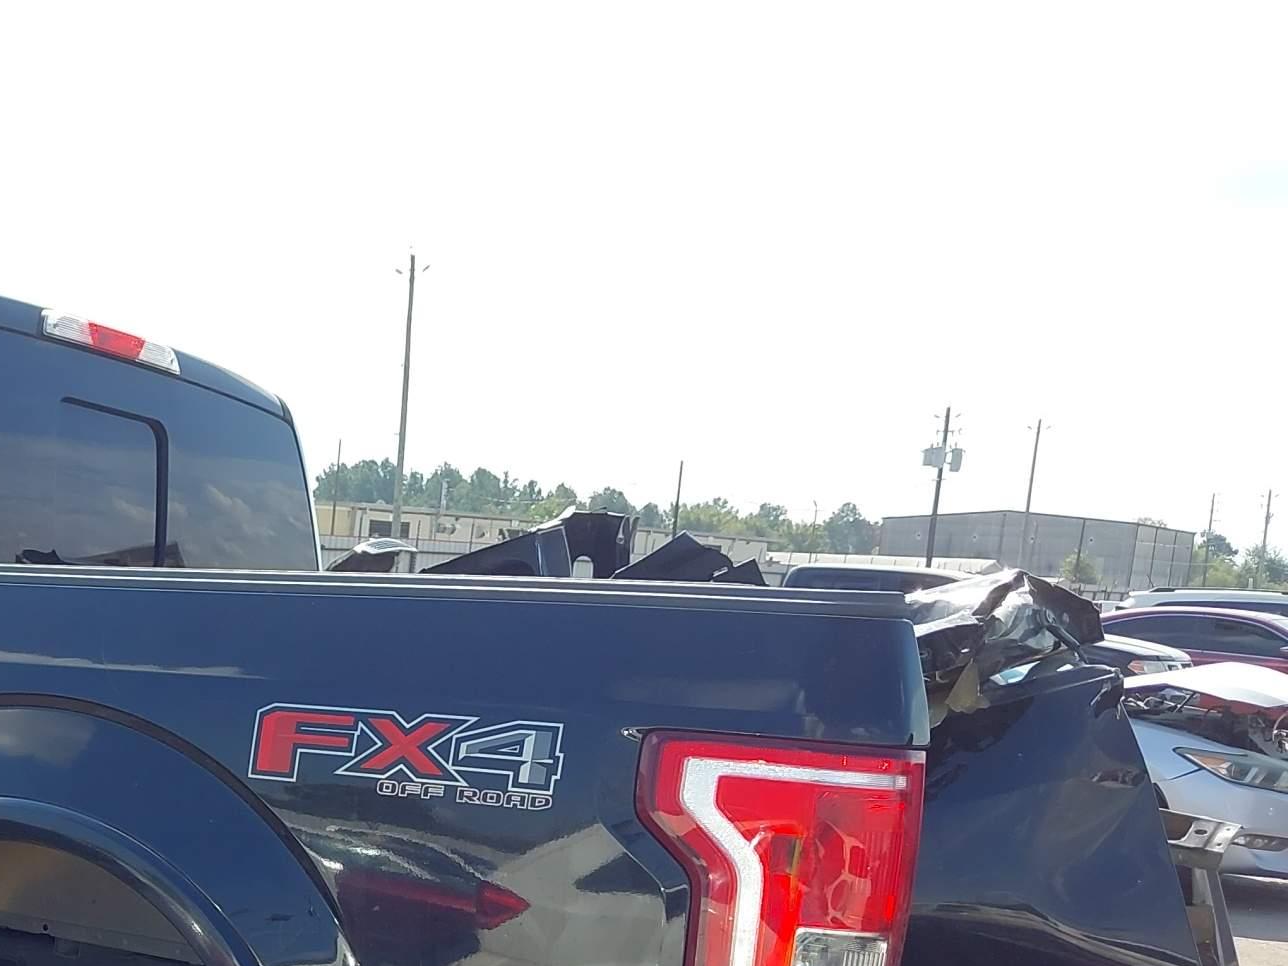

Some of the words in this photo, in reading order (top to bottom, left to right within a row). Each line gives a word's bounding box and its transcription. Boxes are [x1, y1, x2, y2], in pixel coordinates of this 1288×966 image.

[248, 702, 564, 796] FX4
[376, 780, 444, 799] OFF
[456, 787, 553, 811] ROAD
